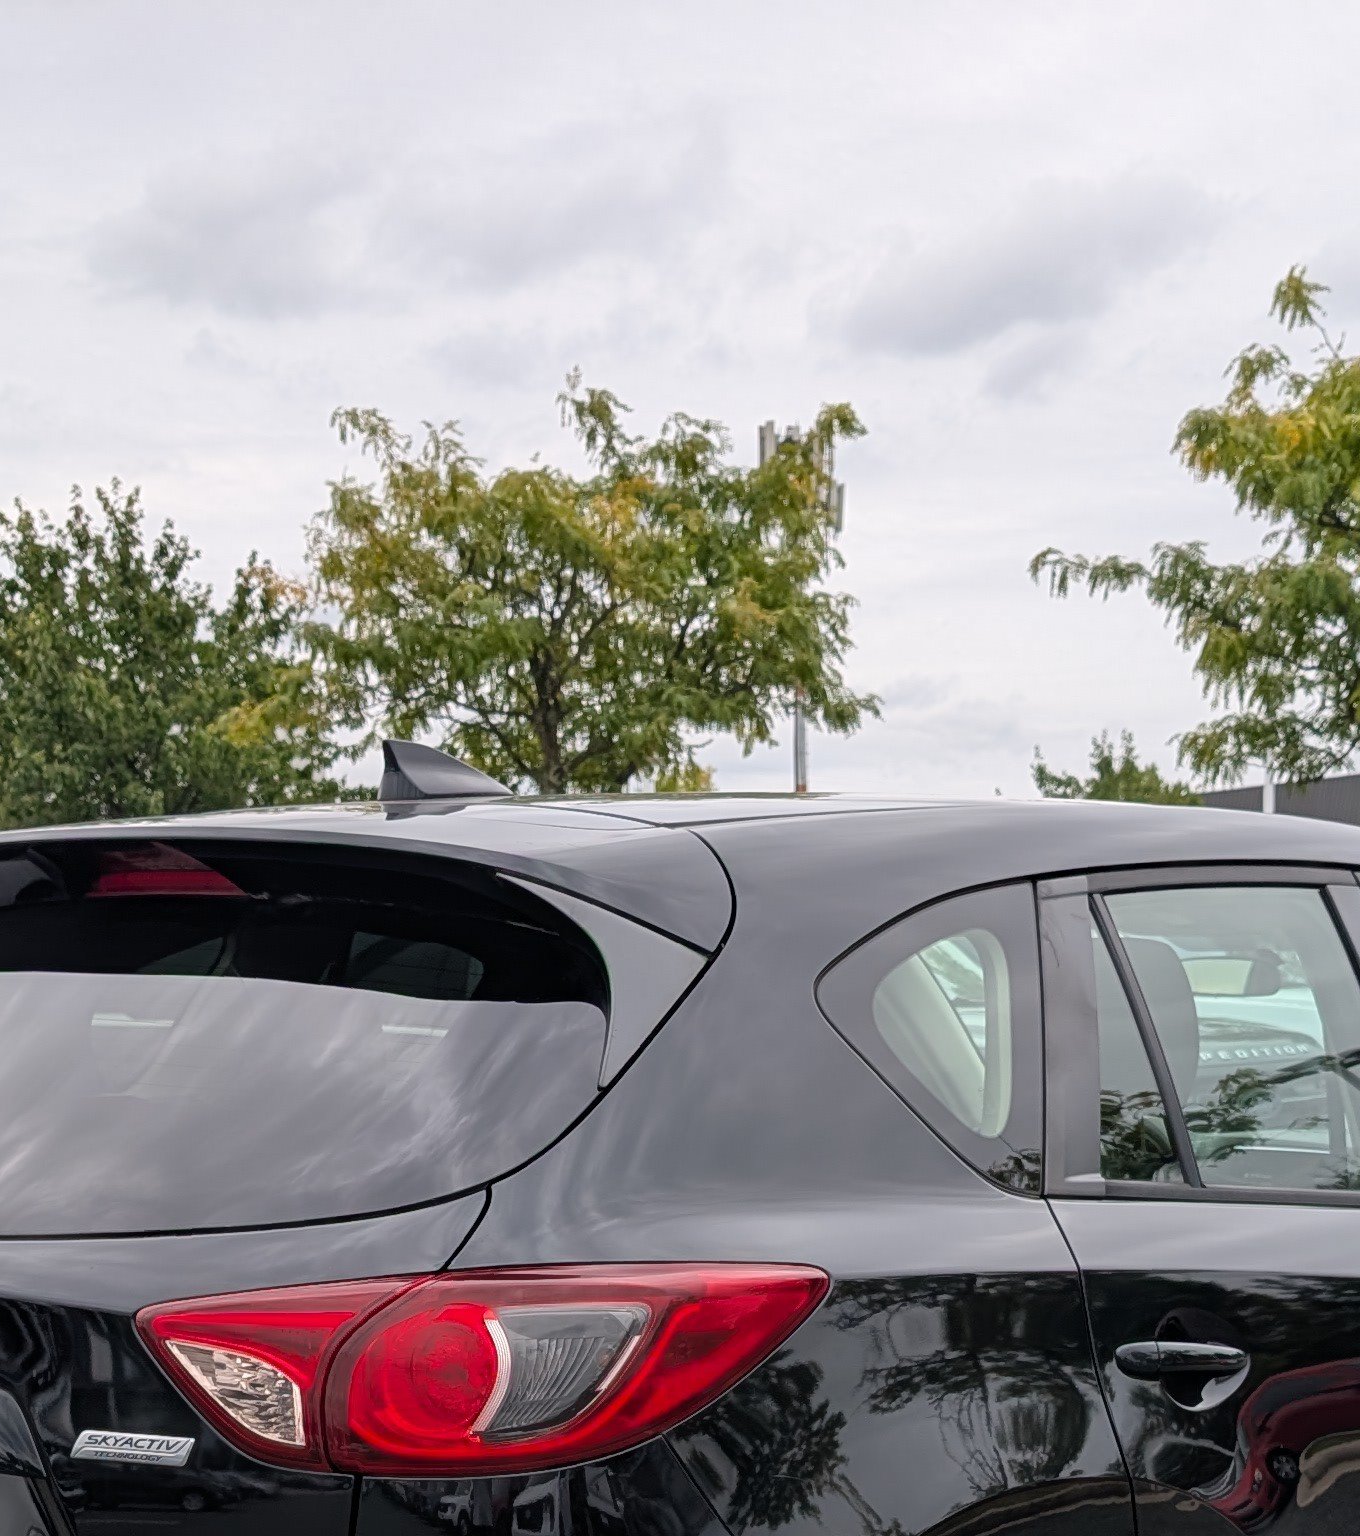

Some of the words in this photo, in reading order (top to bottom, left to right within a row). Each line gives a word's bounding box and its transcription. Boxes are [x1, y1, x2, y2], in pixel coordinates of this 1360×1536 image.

[1199, 1043, 1309, 1061] PEDITION
[84, 1434, 181, 1451] SKYACTIV
[93, 1450, 163, 1462] TECHNOLOGY
